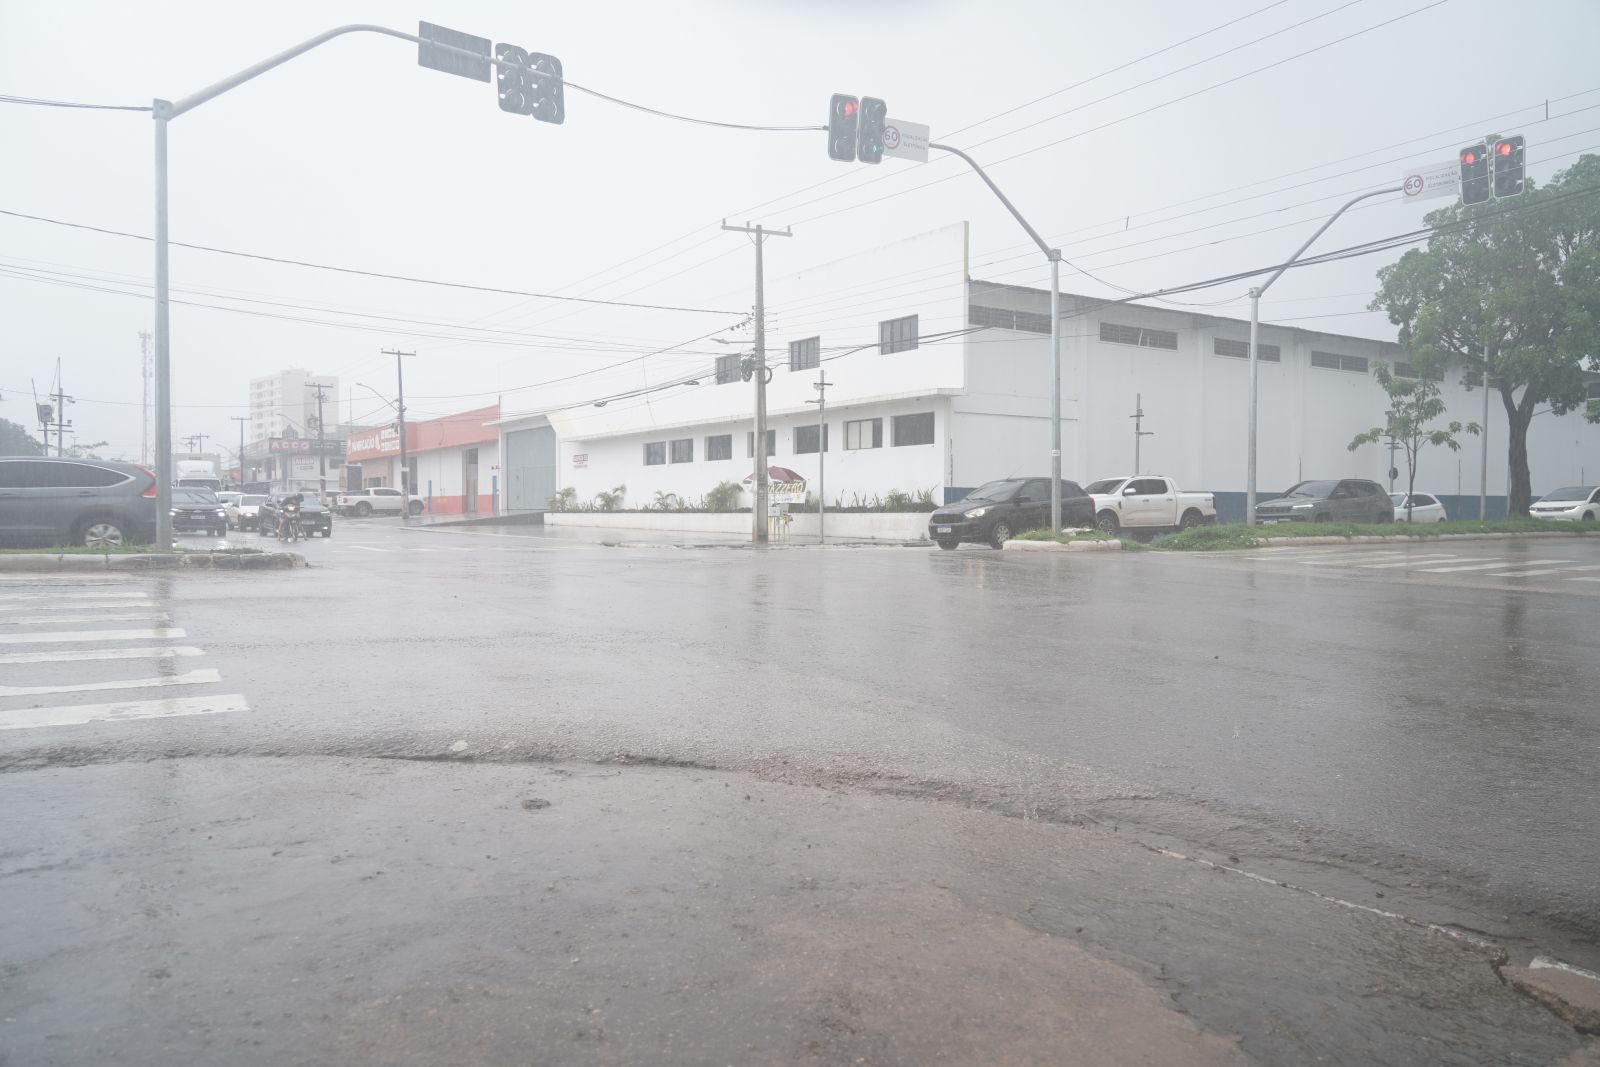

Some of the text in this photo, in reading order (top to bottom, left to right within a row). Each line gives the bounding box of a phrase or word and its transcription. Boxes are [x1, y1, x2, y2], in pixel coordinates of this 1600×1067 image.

[885, 130, 898, 142] 60
[1407, 178, 1422, 190] 60
[271, 439, 309, 450] ACCO
